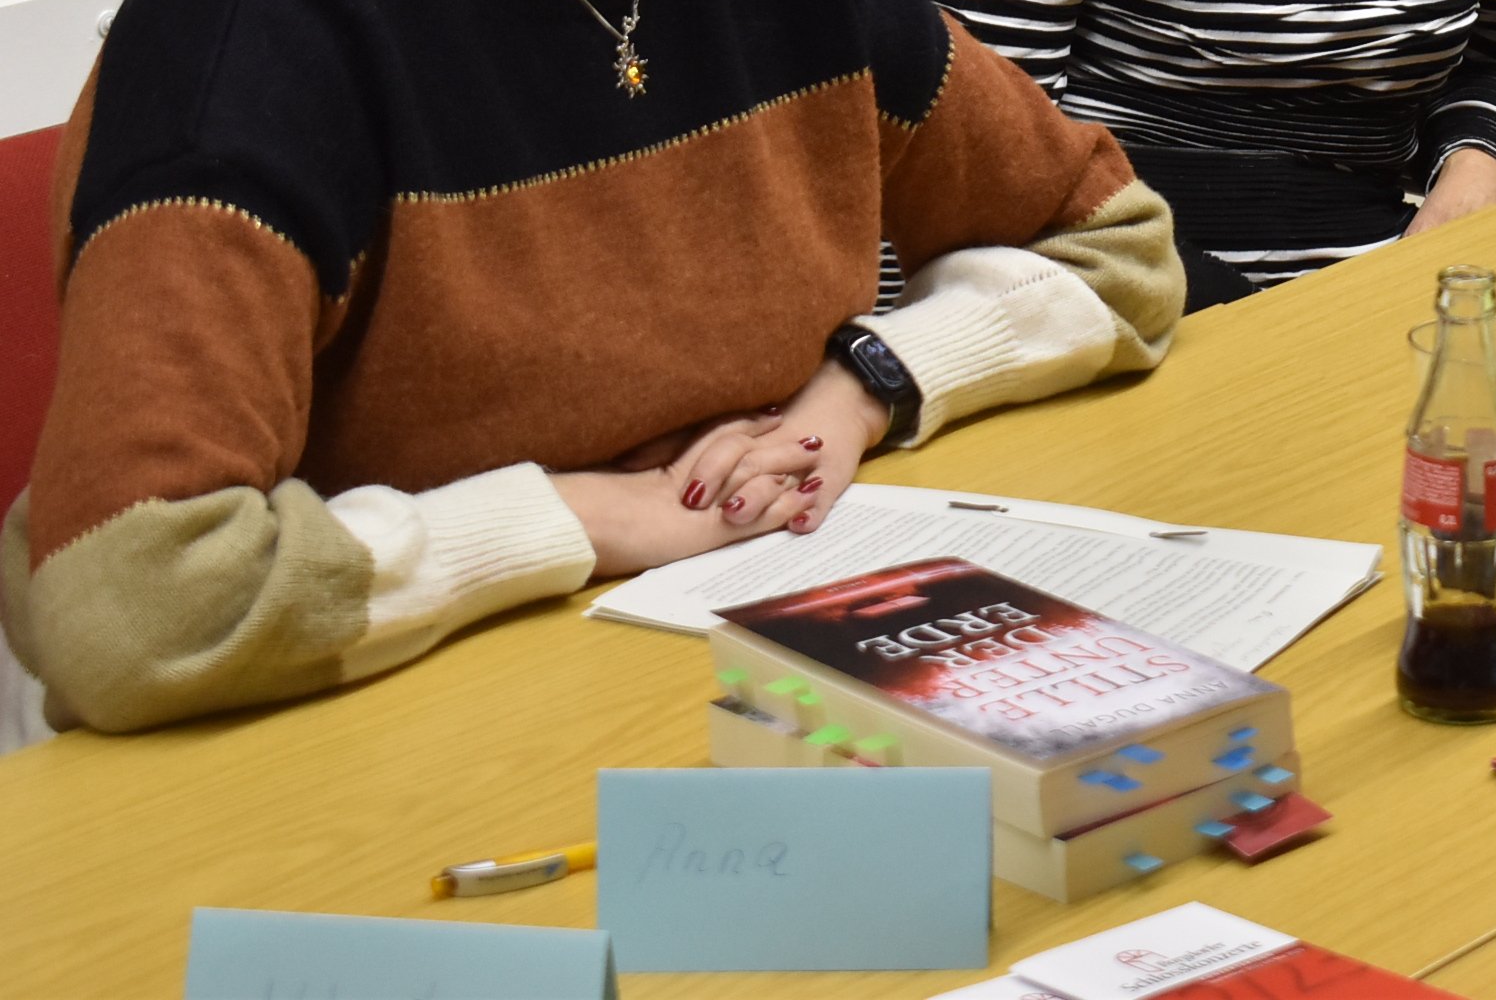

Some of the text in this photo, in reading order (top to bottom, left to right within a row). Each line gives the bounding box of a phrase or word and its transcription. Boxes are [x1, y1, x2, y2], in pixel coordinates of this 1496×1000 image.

[856, 601, 1041, 662] ERDE
[920, 624, 1065, 670] DER
[936, 636, 1155, 700] UNTER
[980, 654, 1192, 722] STILLE
[1159, 678, 1230, 706] ANNA
